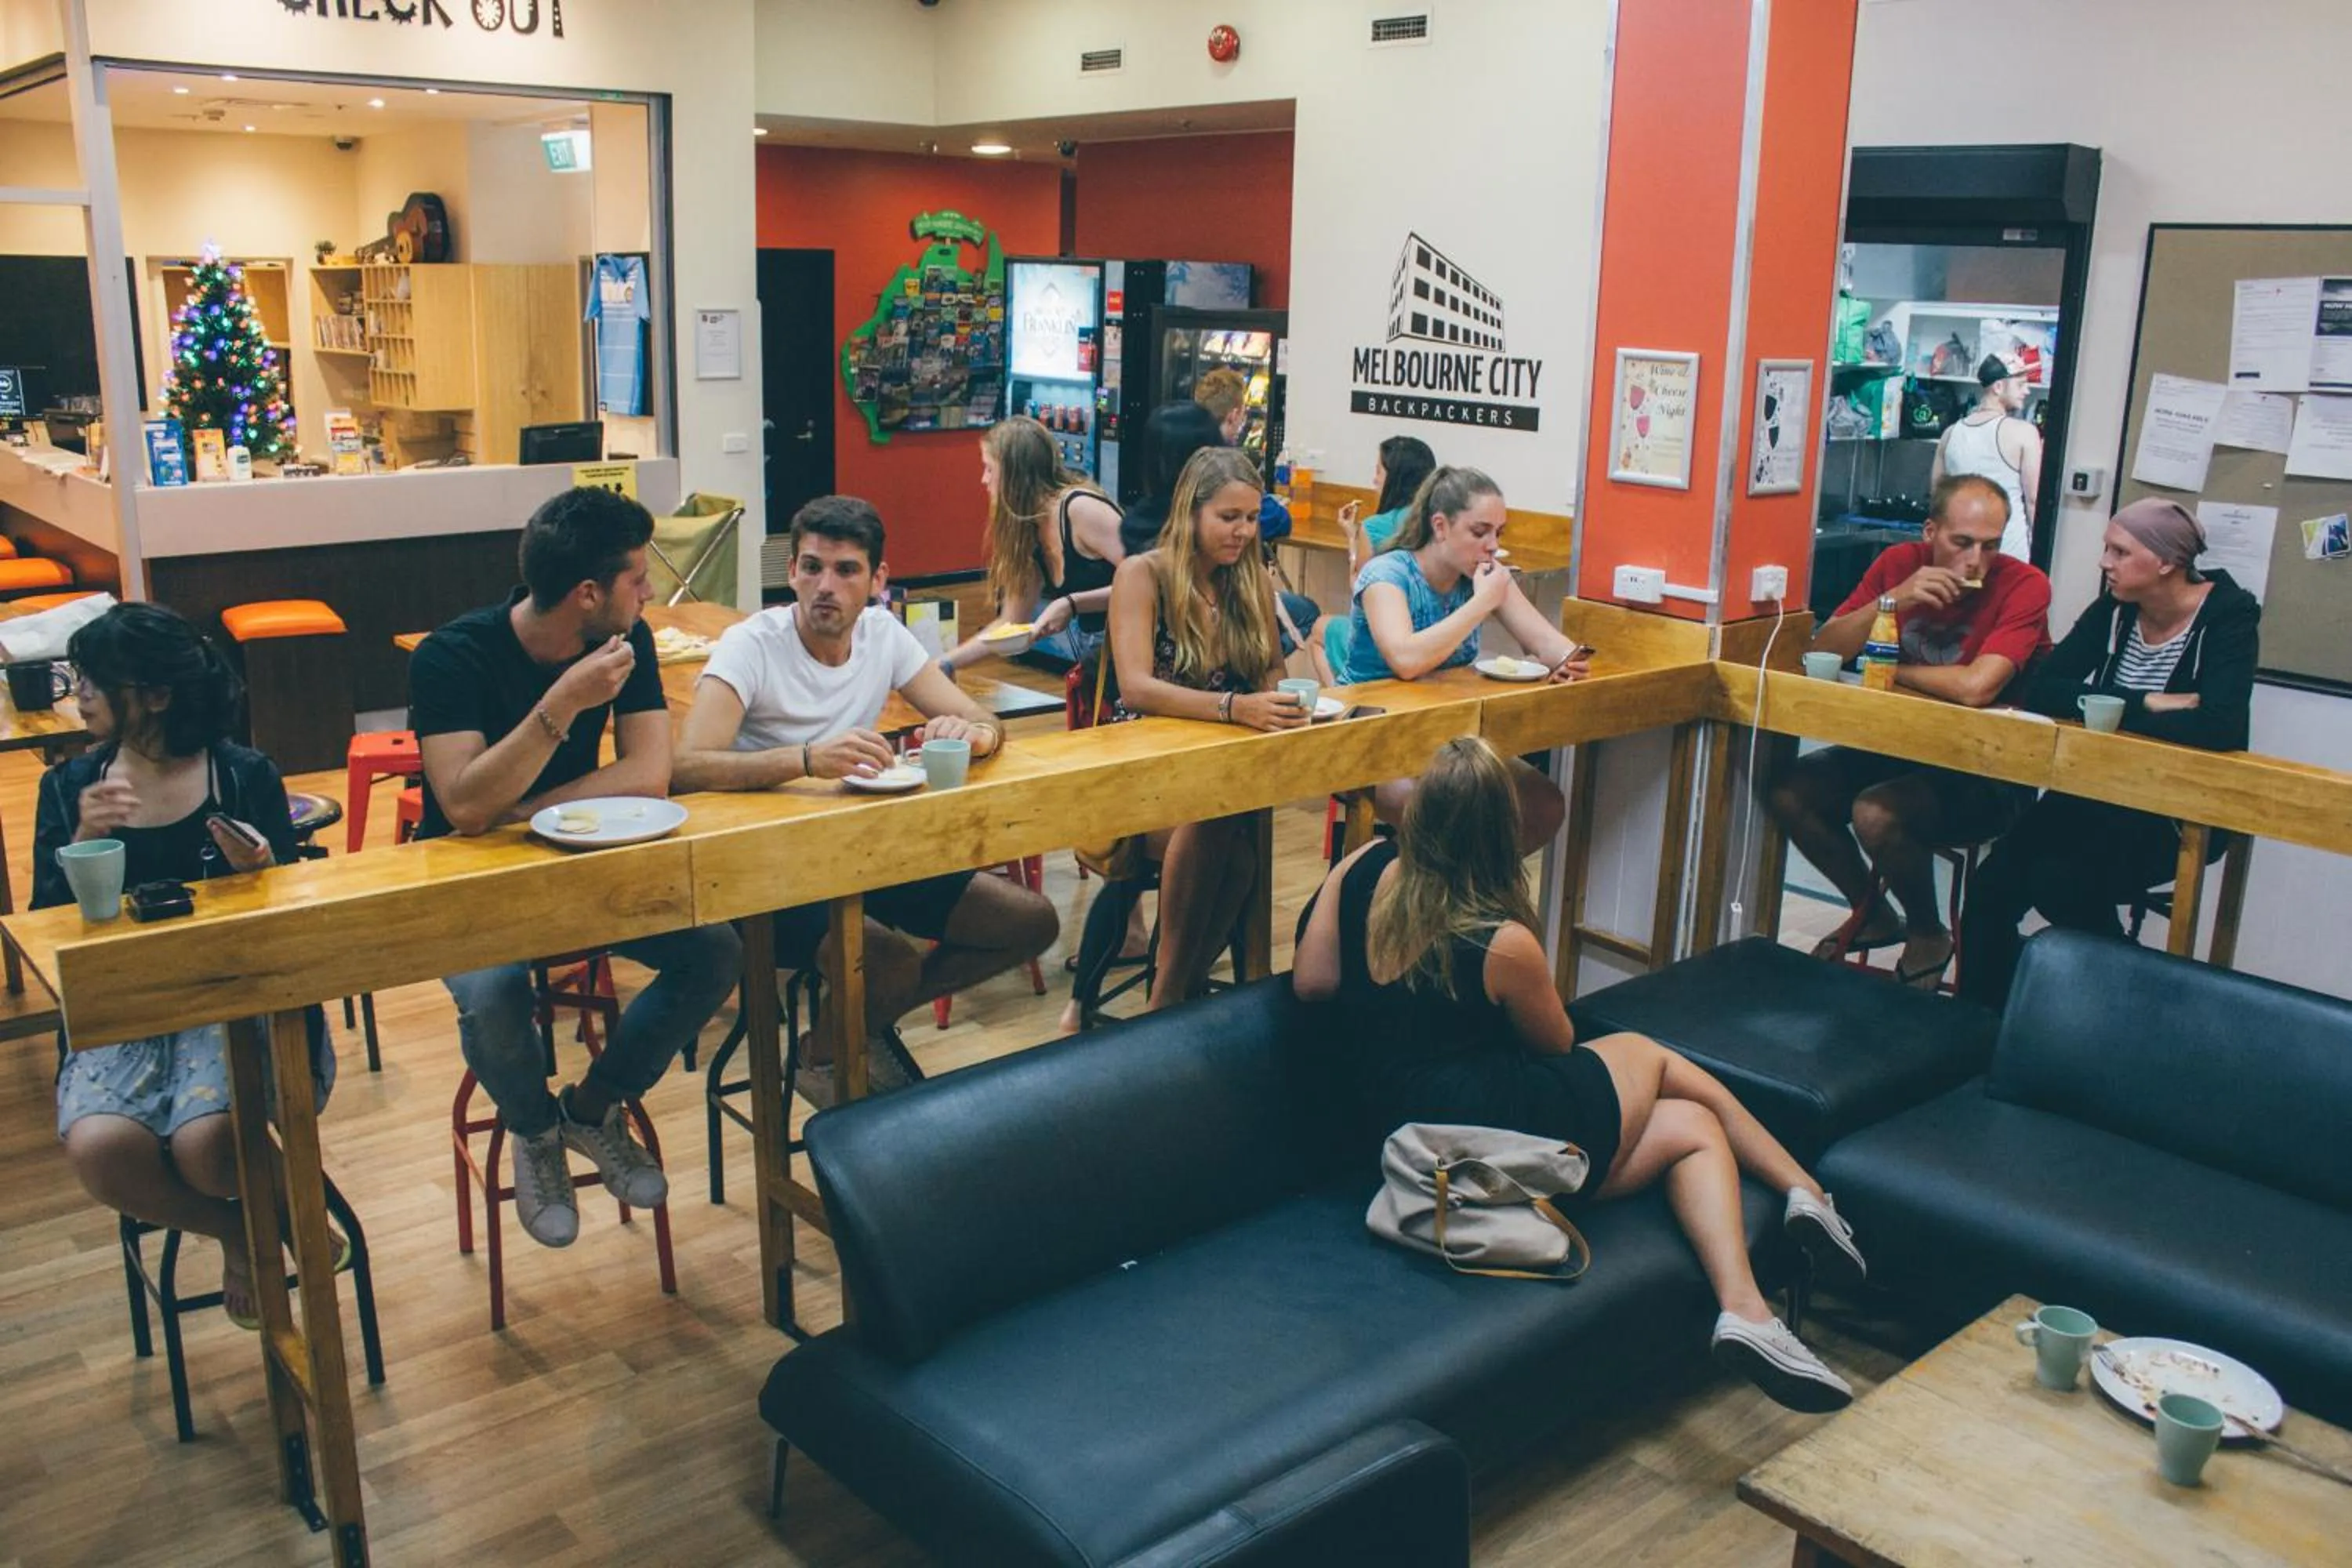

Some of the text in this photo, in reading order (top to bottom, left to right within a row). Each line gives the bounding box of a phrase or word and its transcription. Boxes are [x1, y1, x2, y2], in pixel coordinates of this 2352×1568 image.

[471, 0, 564, 38] OUT
[1352, 347, 1543, 399] MELBOURNE CITY
[1650, 363, 1676, 376] Wine
[1654, 383, 1687, 398] Cheese
[1367, 397, 1513, 426] BACKPACKERS
[1656, 403, 1686, 419] Night
